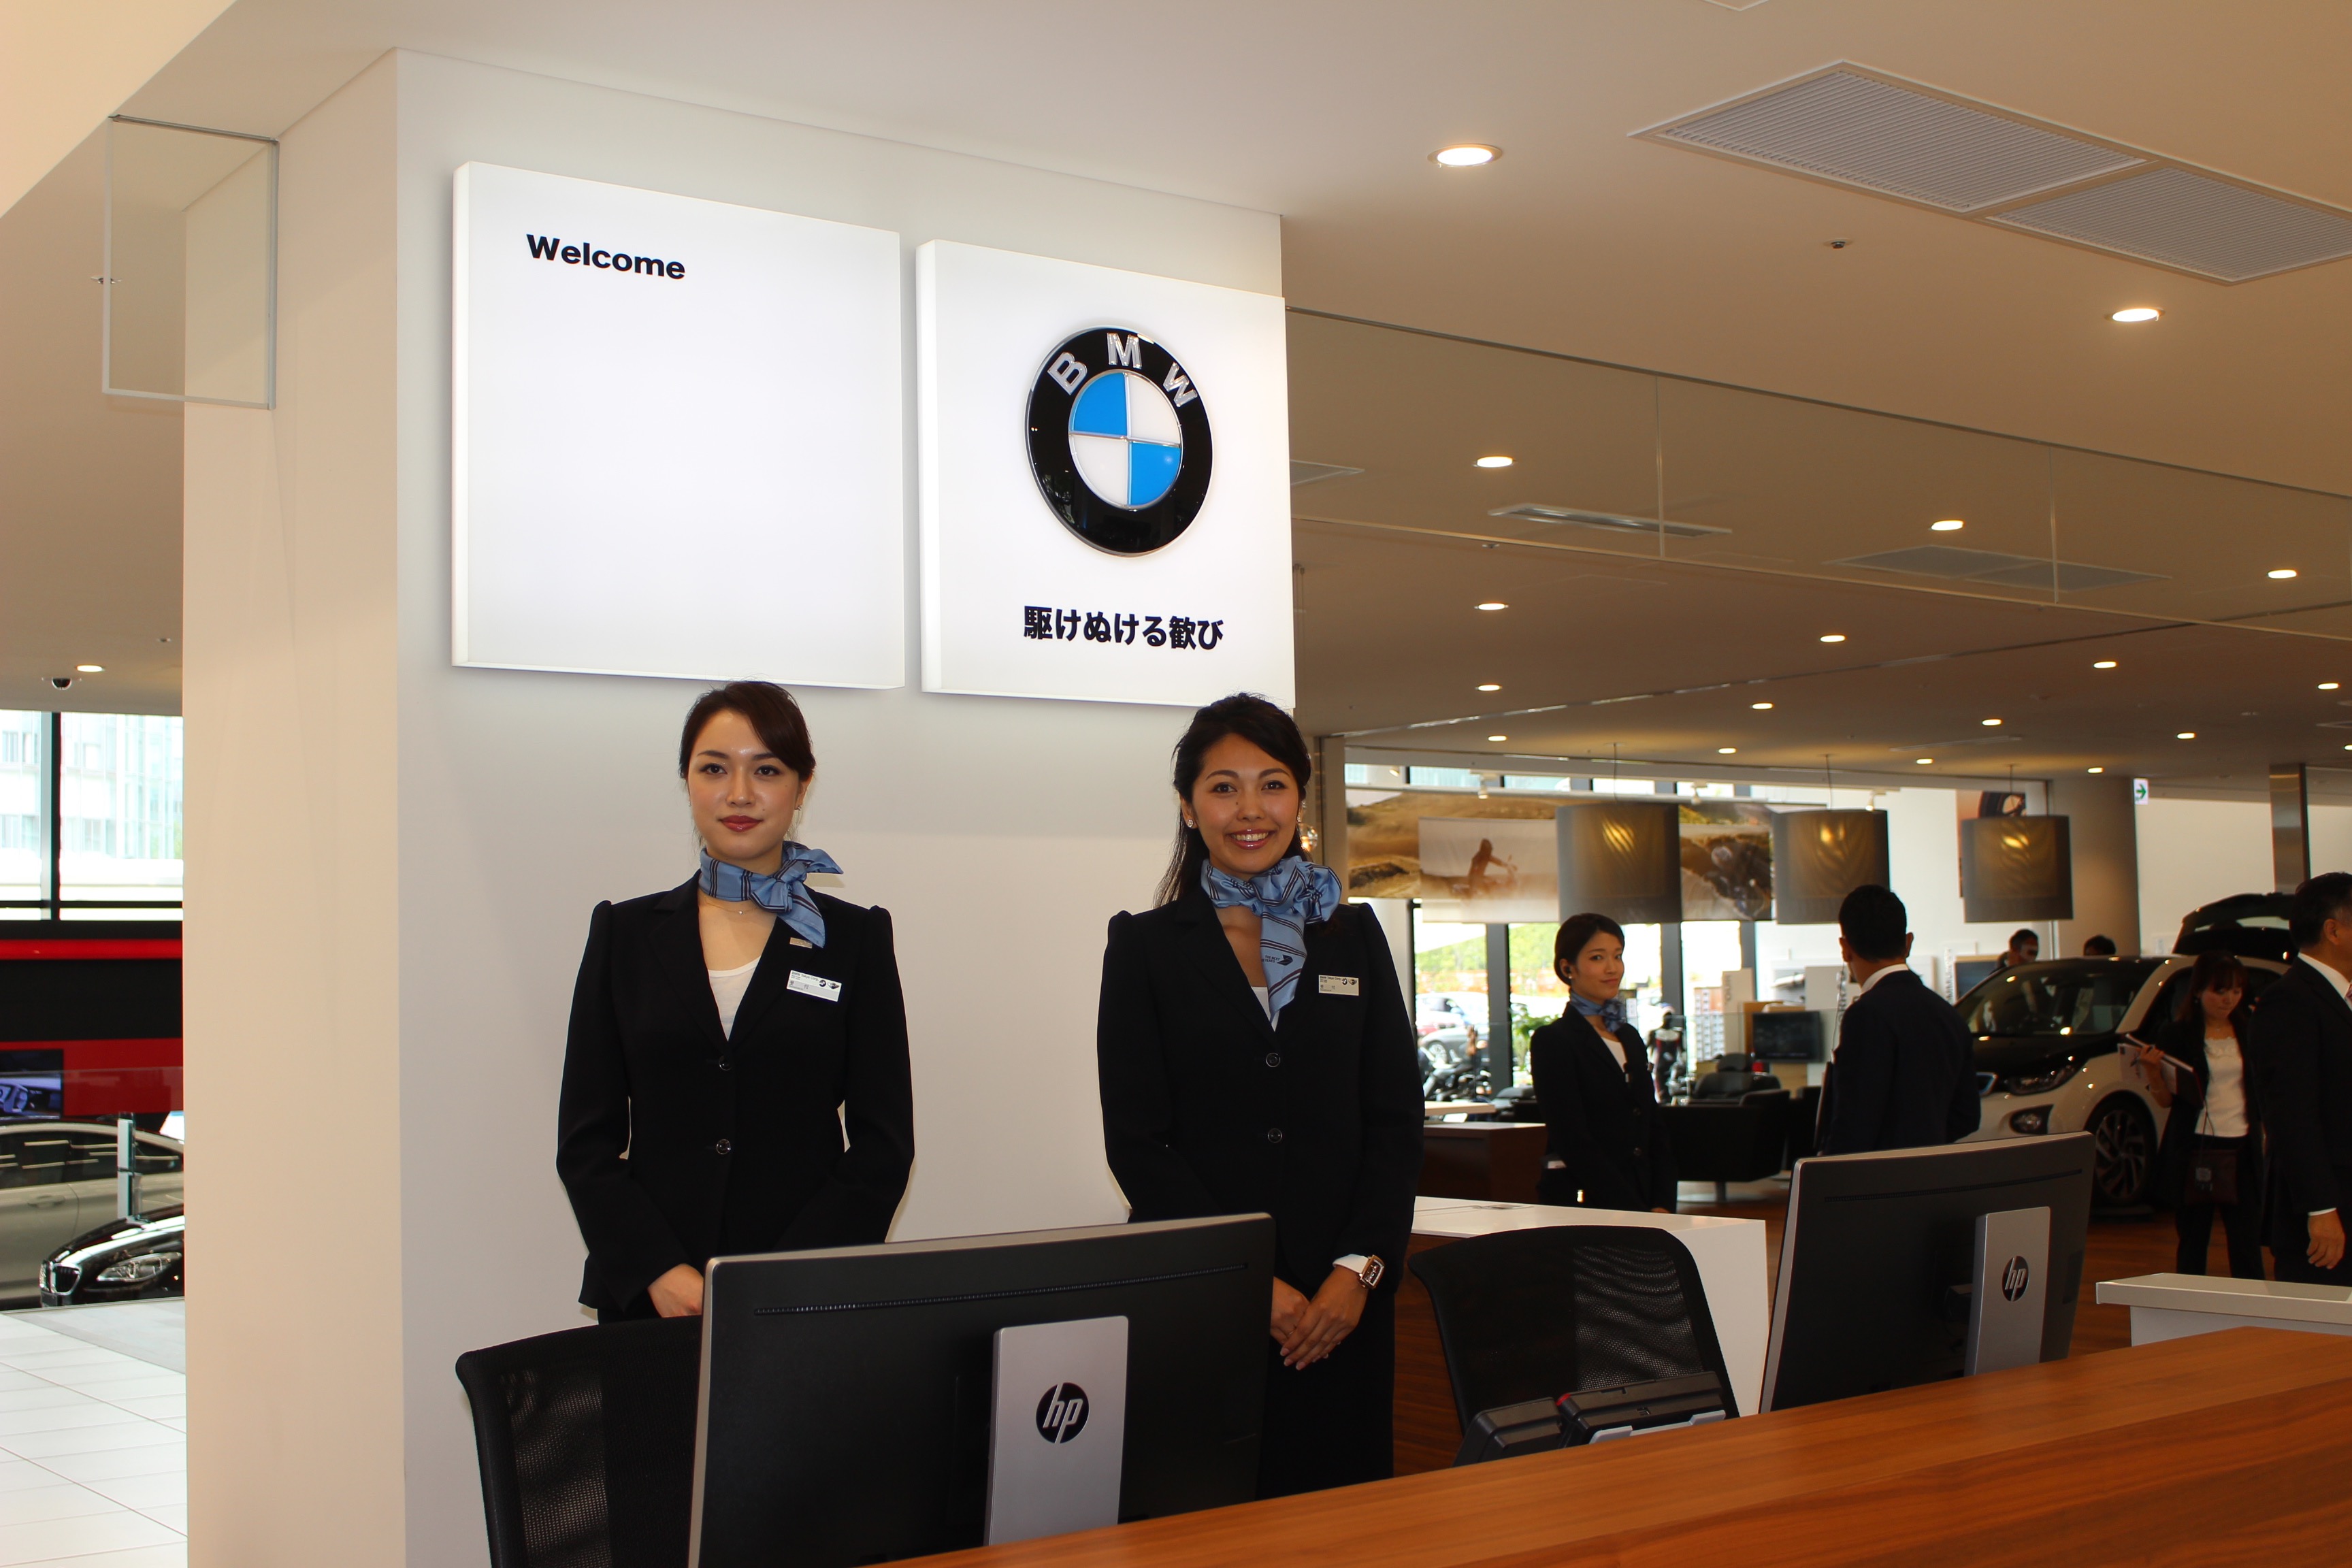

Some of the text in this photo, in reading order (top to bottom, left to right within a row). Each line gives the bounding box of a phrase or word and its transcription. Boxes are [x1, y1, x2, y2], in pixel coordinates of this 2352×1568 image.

[526, 233, 685, 280] Welcome
[1047, 332, 1198, 408] BMW
[1024, 605, 1224, 650] 駆けぬける歓び
[2005, 1256, 2027, 1301] hp
[1042, 1383, 1083, 1443] hp
